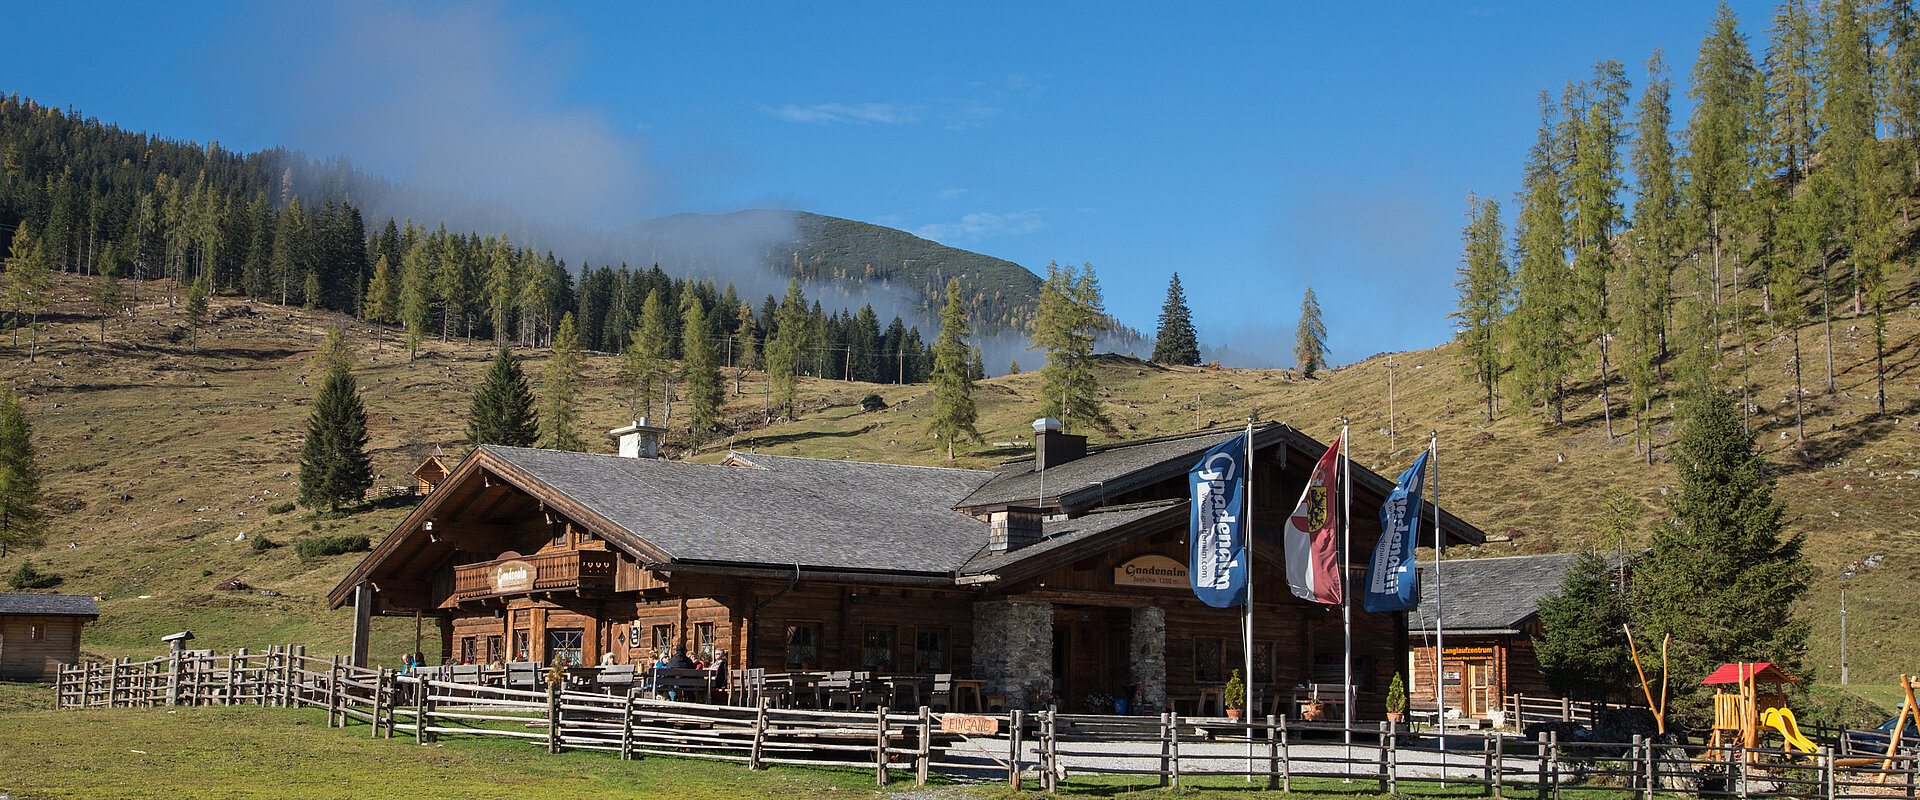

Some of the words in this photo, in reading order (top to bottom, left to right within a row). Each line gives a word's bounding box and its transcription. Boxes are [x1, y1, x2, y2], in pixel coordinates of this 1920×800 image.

[1198, 452, 1238, 590] Gnadenalm
[1125, 564, 1186, 577] Gnadenalm
[1442, 647, 1493, 655] Langlaufzentrum
[949, 718, 991, 731] EINGANG
